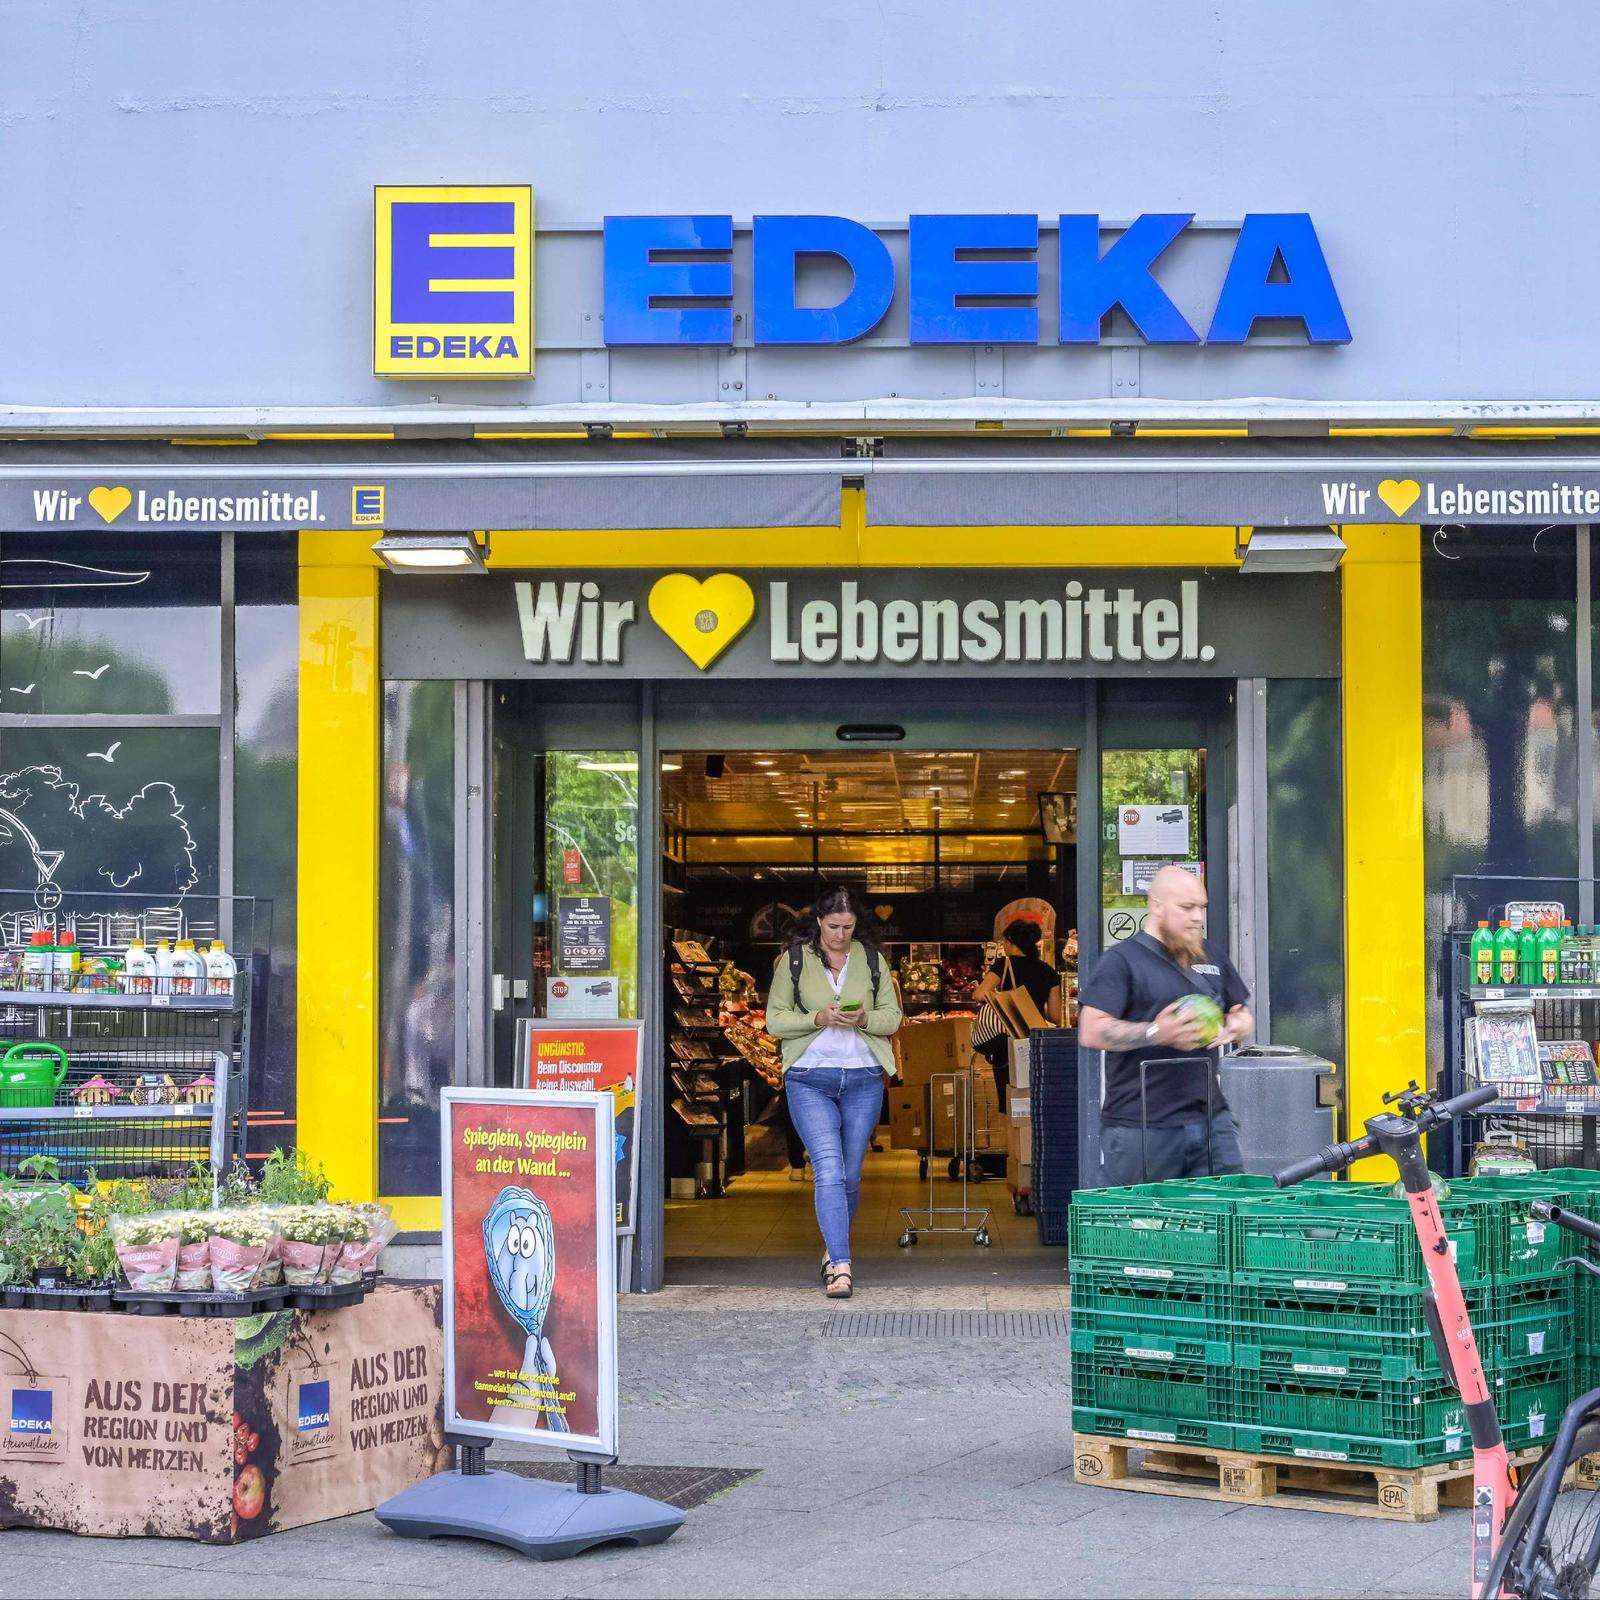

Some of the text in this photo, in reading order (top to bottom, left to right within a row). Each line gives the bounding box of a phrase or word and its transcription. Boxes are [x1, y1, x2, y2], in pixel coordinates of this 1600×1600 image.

[603, 213, 1353, 346] EDEKA
[390, 335, 519, 358] EDEKA
[33, 489, 326, 522] Wir Lebensmittel.
[1321, 482, 1370, 515] Wir
[515, 579, 1217, 664] Wir Lebensmittel.
[1124, 813, 1139, 822] STOP
[552, 985, 568, 995] STOP
[538, 1040, 586, 1057] UNGÜNSTIG:
[537, 1060, 603, 1075] Beim Discounter
[463, 1126, 587, 1154] Spieglein, Spieglein
[475, 1158, 491, 1173] an
[493, 1155, 515, 1174] der
[517, 1157, 556, 1176] Wand
[350, 1345, 427, 1391] AUS DER
[84, 1378, 208, 1415] AUS DER
[351, 1383, 427, 1422] REGION UND
[10, 1418, 52, 1431] EDEKA
[83, 1416, 208, 1443] REGION UND
[298, 1412, 330, 1427] EDEKA
[350, 1425, 378, 1452] VON
[82, 1445, 122, 1468] VON
[1079, 1458, 1098, 1473] EPAL
